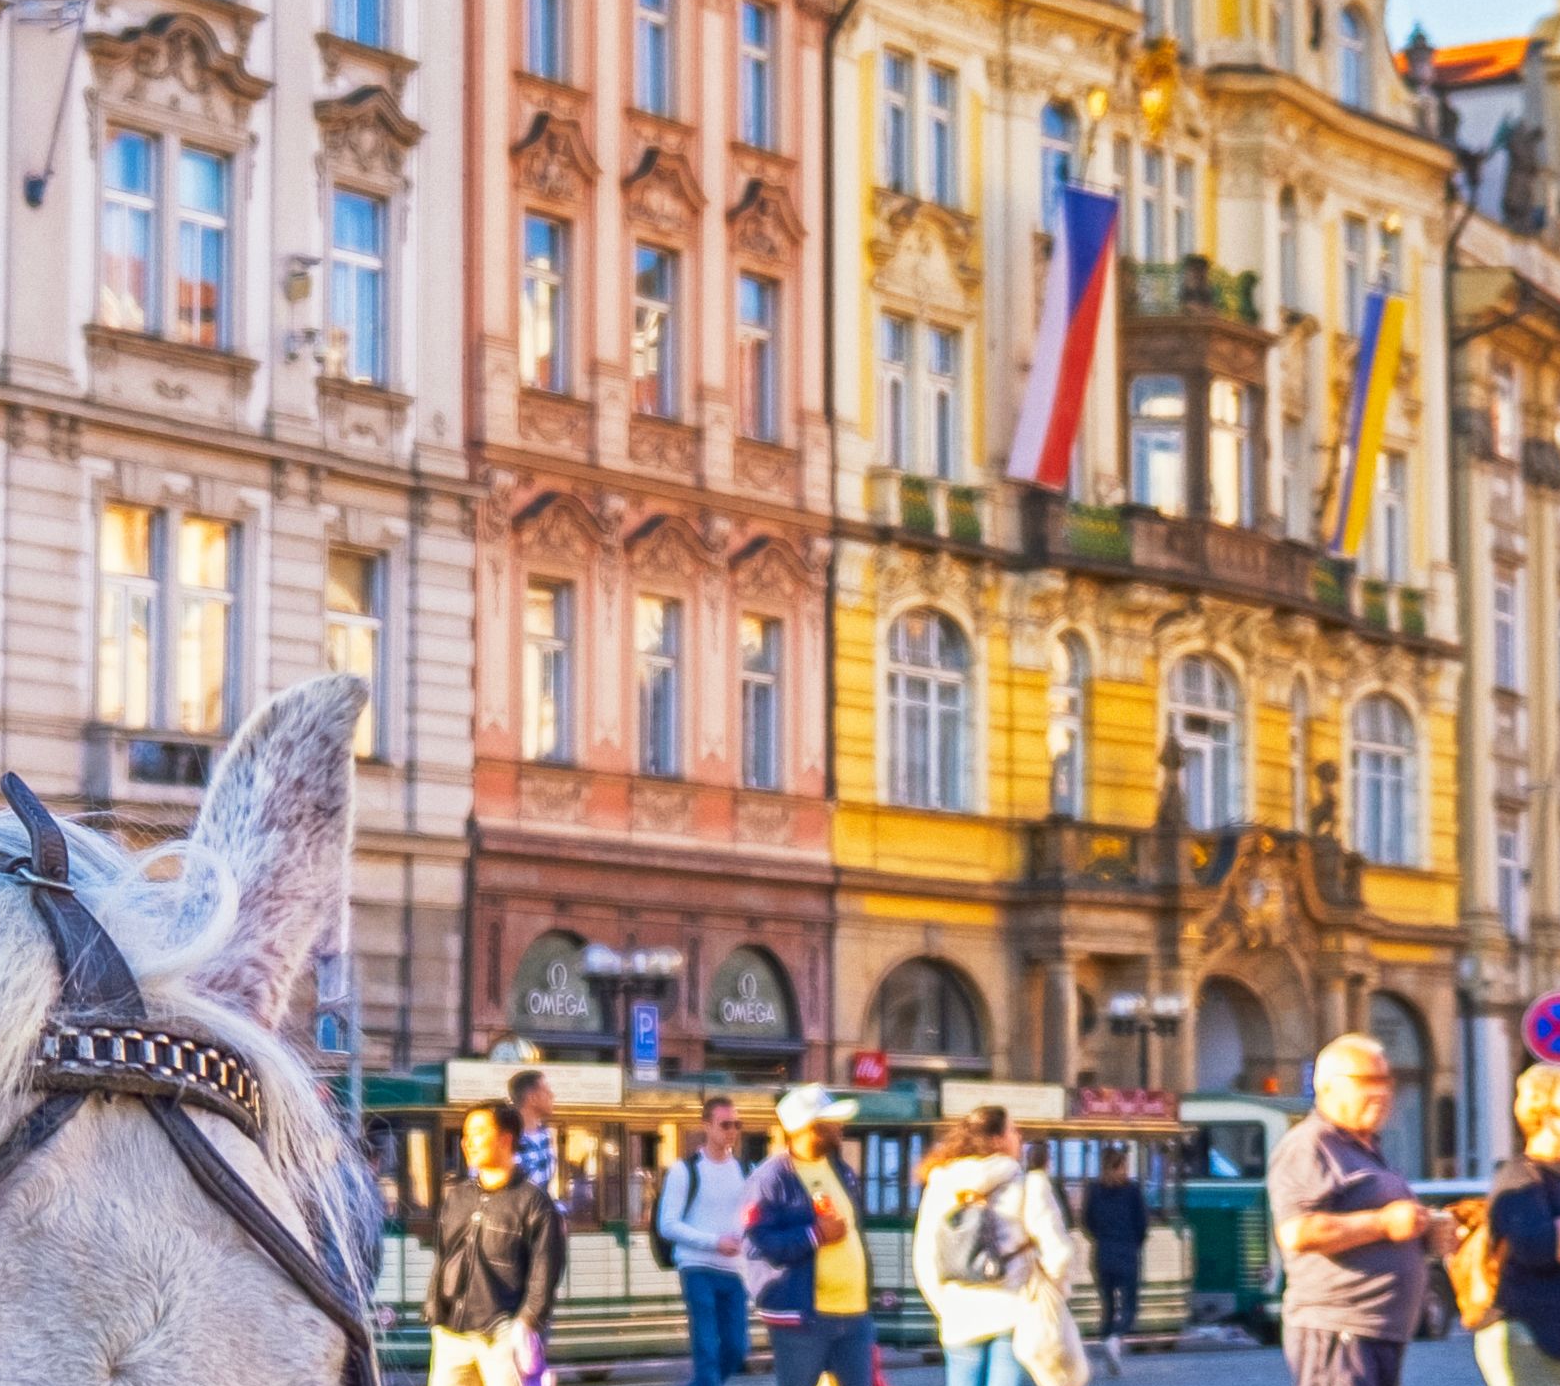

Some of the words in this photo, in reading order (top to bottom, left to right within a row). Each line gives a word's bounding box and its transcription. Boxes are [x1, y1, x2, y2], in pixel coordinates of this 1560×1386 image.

[529, 992, 590, 1016] OMEGA
[723, 1001, 778, 1024] OMEGA
[639, 1012, 654, 1045] P
